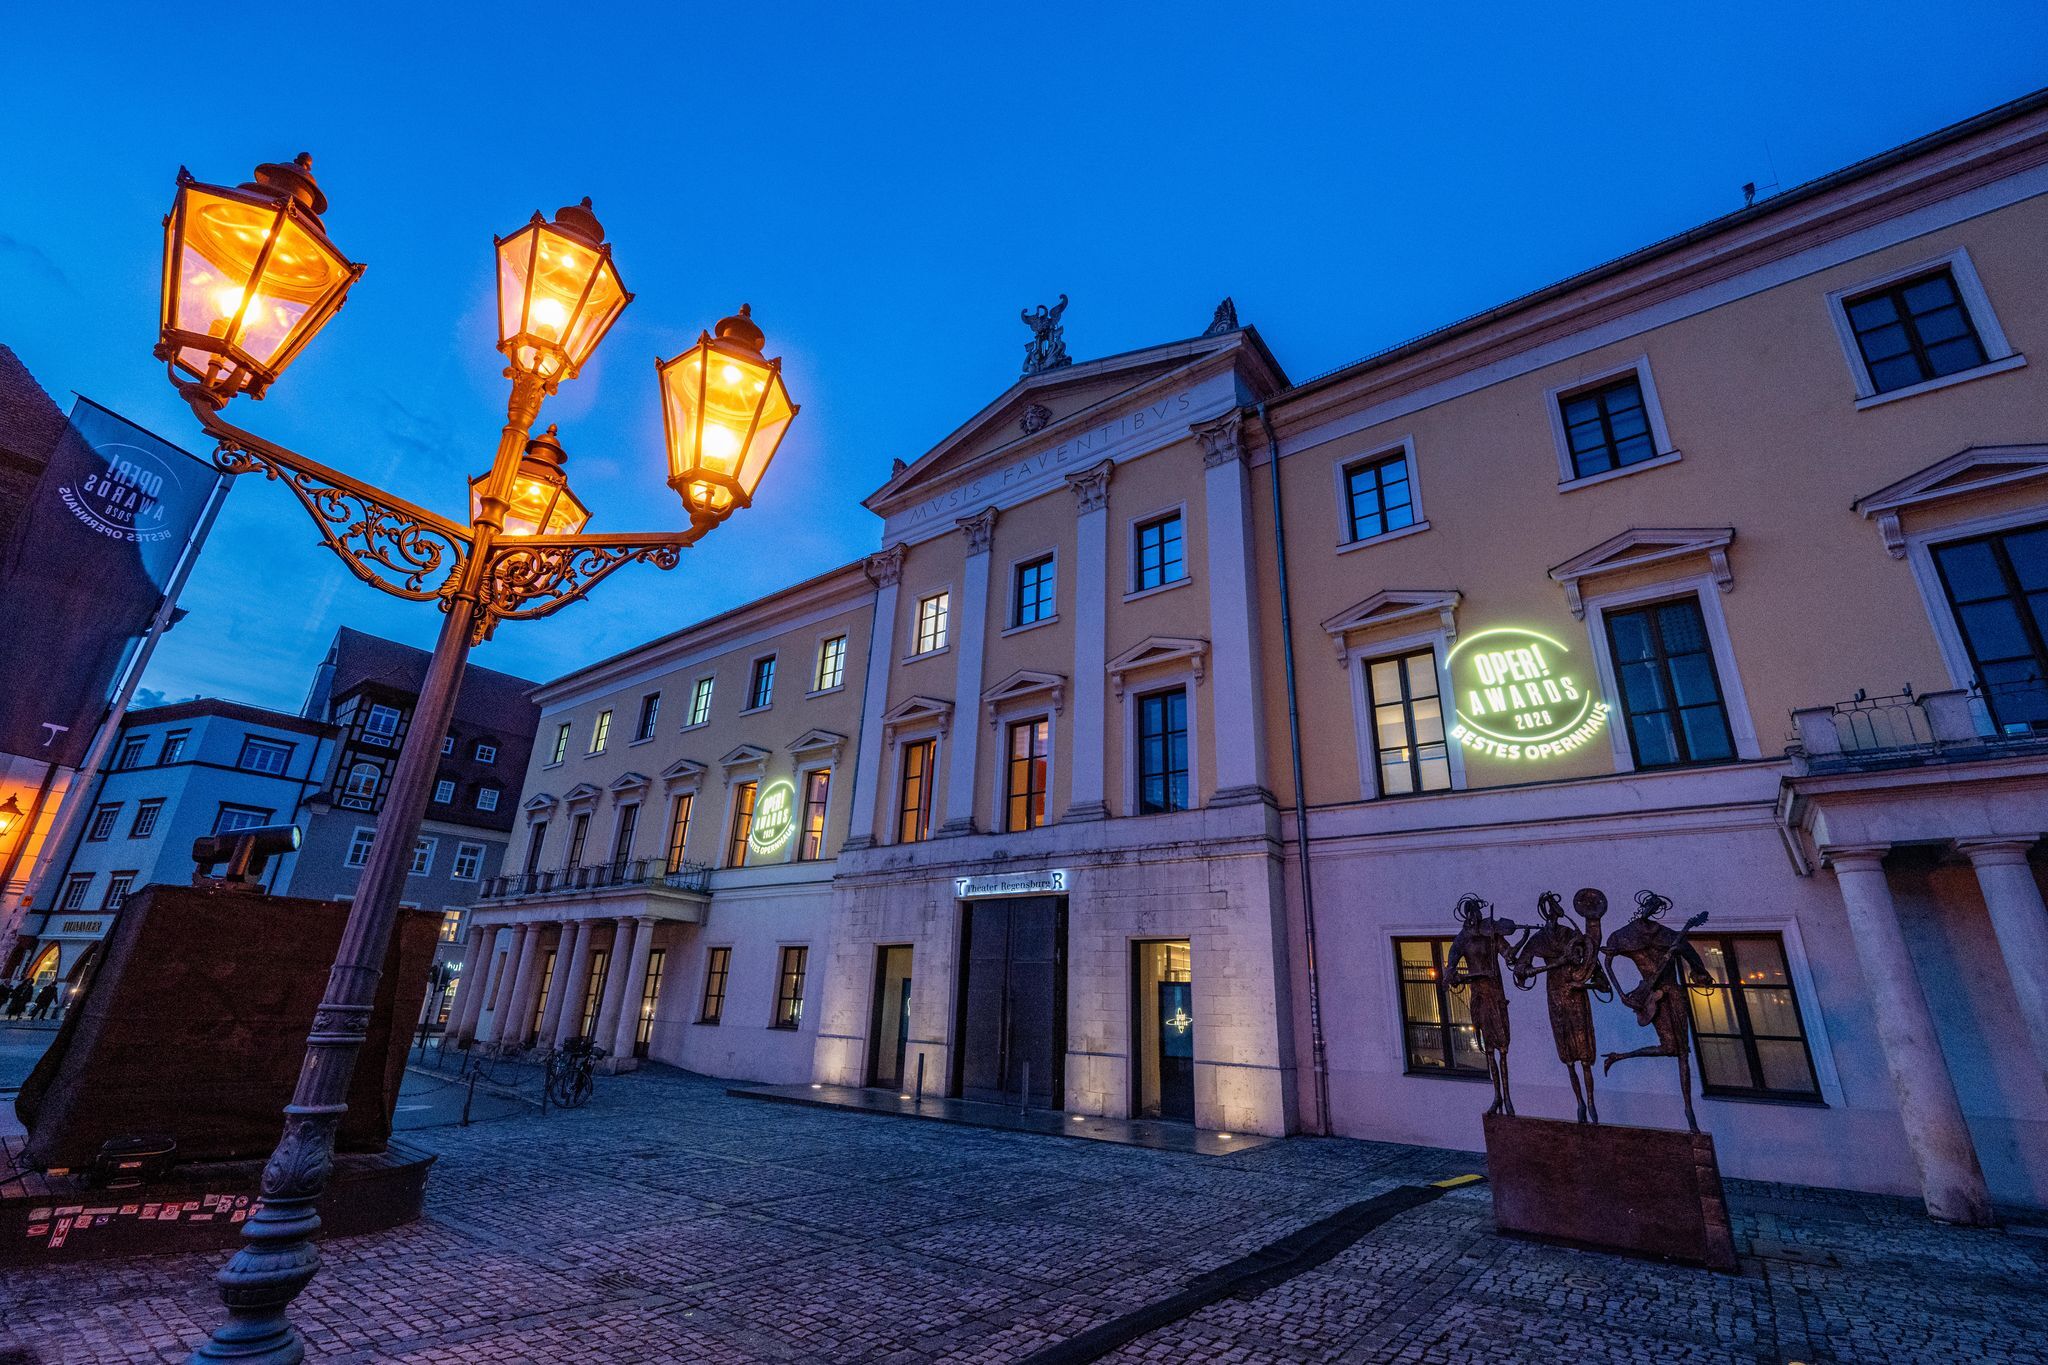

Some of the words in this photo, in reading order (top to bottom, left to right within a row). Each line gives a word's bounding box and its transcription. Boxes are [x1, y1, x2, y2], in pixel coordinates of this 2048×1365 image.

[909, 480, 982, 526] MVSIS
[1002, 393, 1191, 486] FAVENTIBVS
[1473, 643, 1550, 686] OPER!
[1469, 676, 1580, 716] AWARDS
[1451, 724, 1521, 760] BESTES
[1524, 701, 1611, 760] OPERNHAUS
[967, 883, 998, 893] Theater
[1001, 880, 1051, 891] Regensburg
